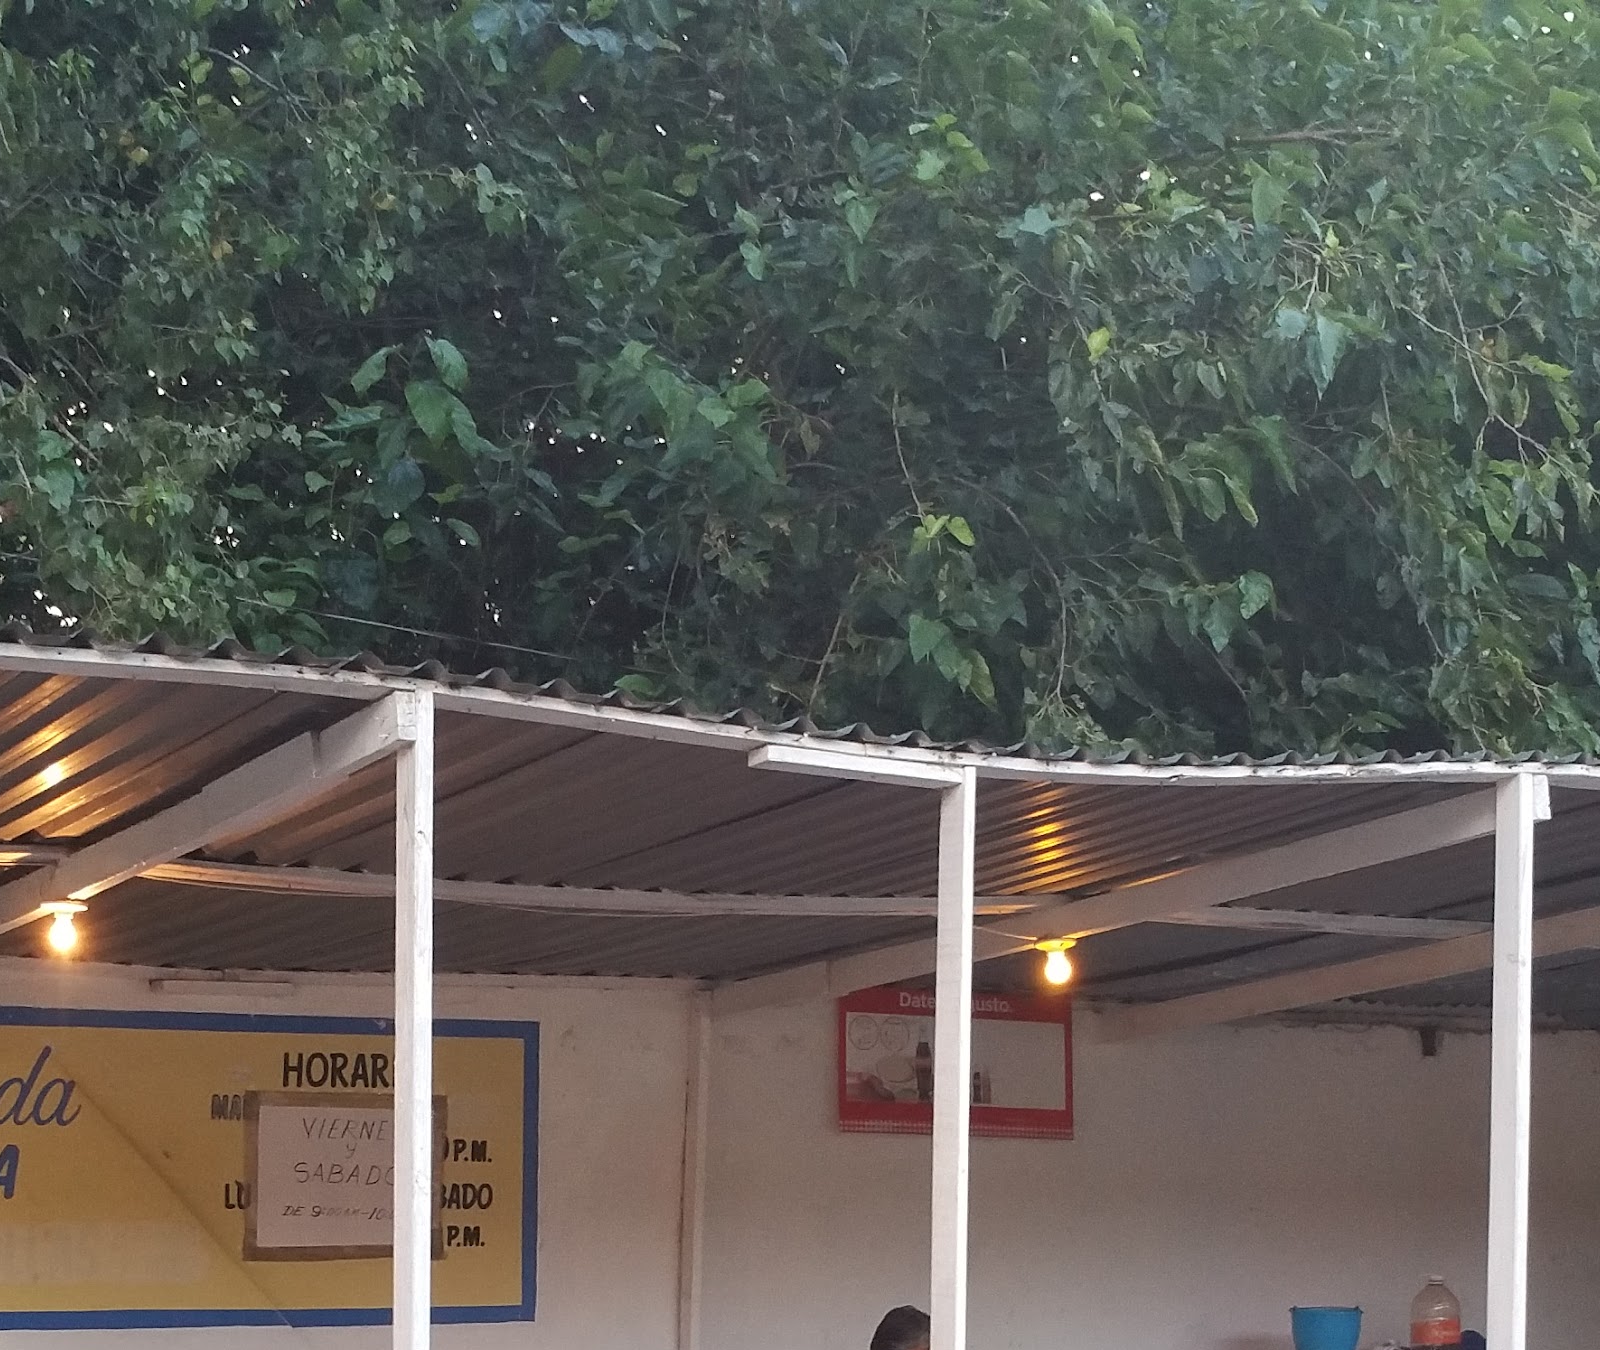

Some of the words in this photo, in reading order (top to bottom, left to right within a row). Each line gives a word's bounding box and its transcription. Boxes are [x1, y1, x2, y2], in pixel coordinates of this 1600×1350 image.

[283, 1052, 395, 1088] HORAR
[302, 1117, 390, 1141] VIERNE
[453, 1138, 492, 1163] P.M.
[446, 1225, 486, 1248] P.M.
